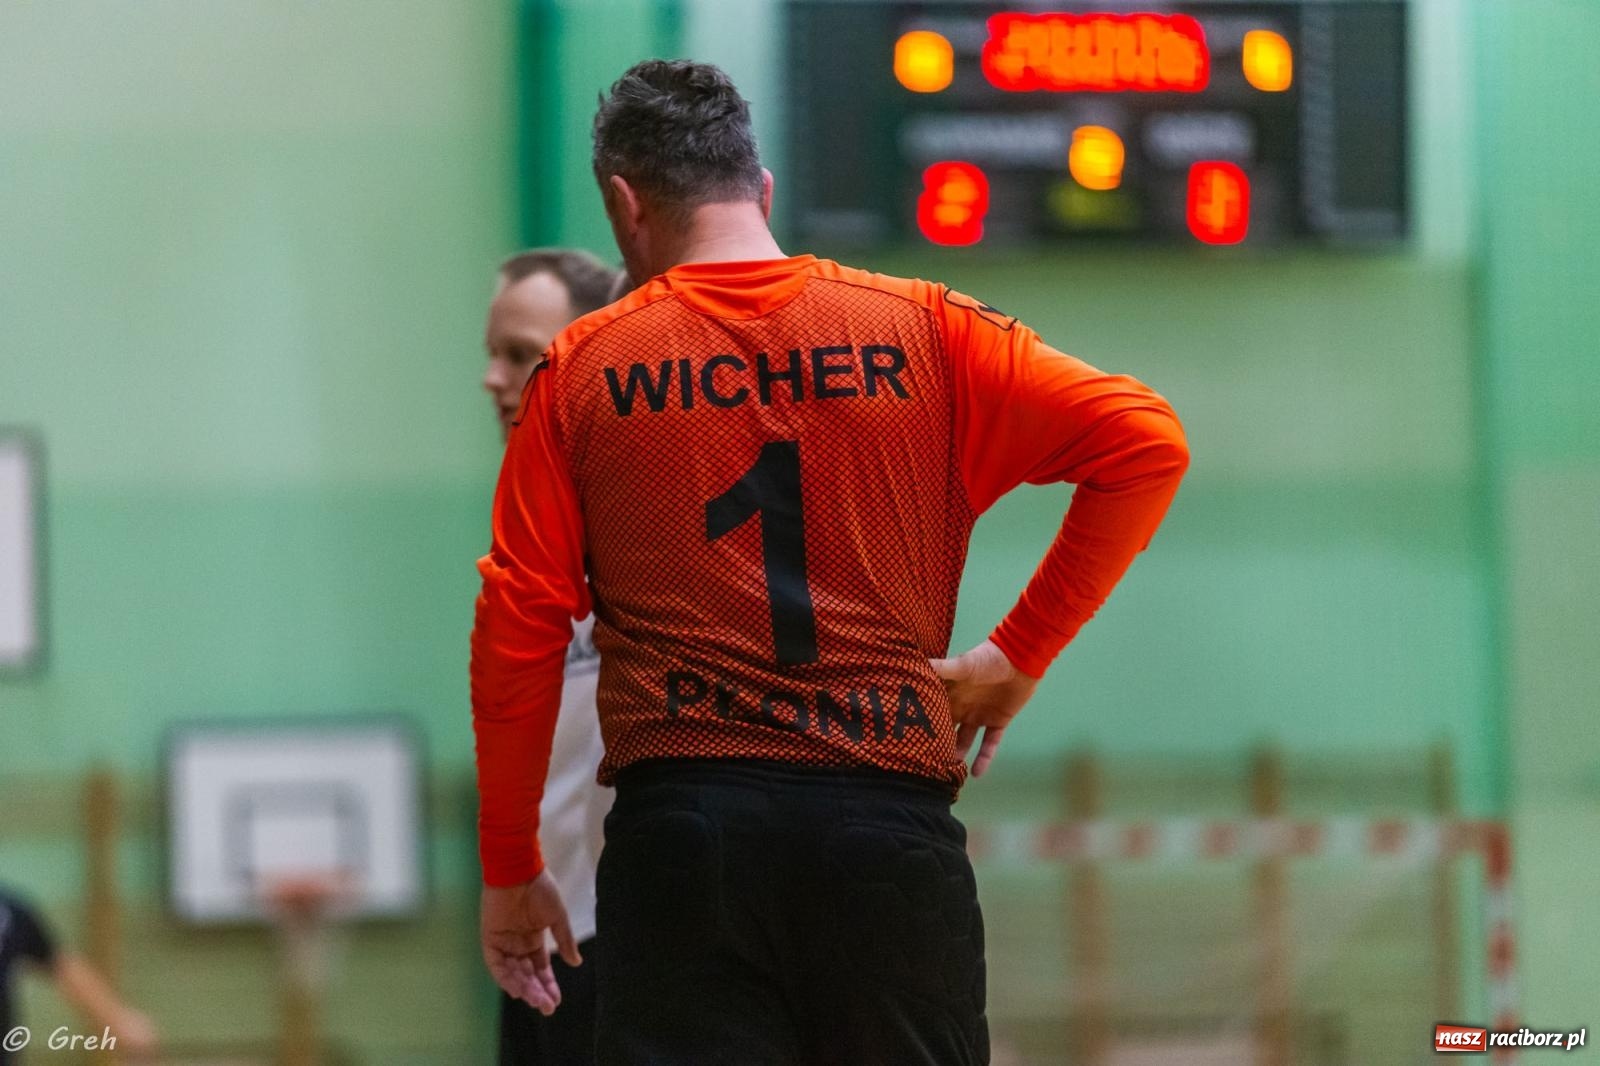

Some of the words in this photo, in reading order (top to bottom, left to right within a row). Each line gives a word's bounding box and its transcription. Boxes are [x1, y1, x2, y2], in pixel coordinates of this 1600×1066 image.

[604, 344, 910, 417] WICHER
[705, 440, 818, 667] 1
[666, 670, 936, 743] PŁONIA
